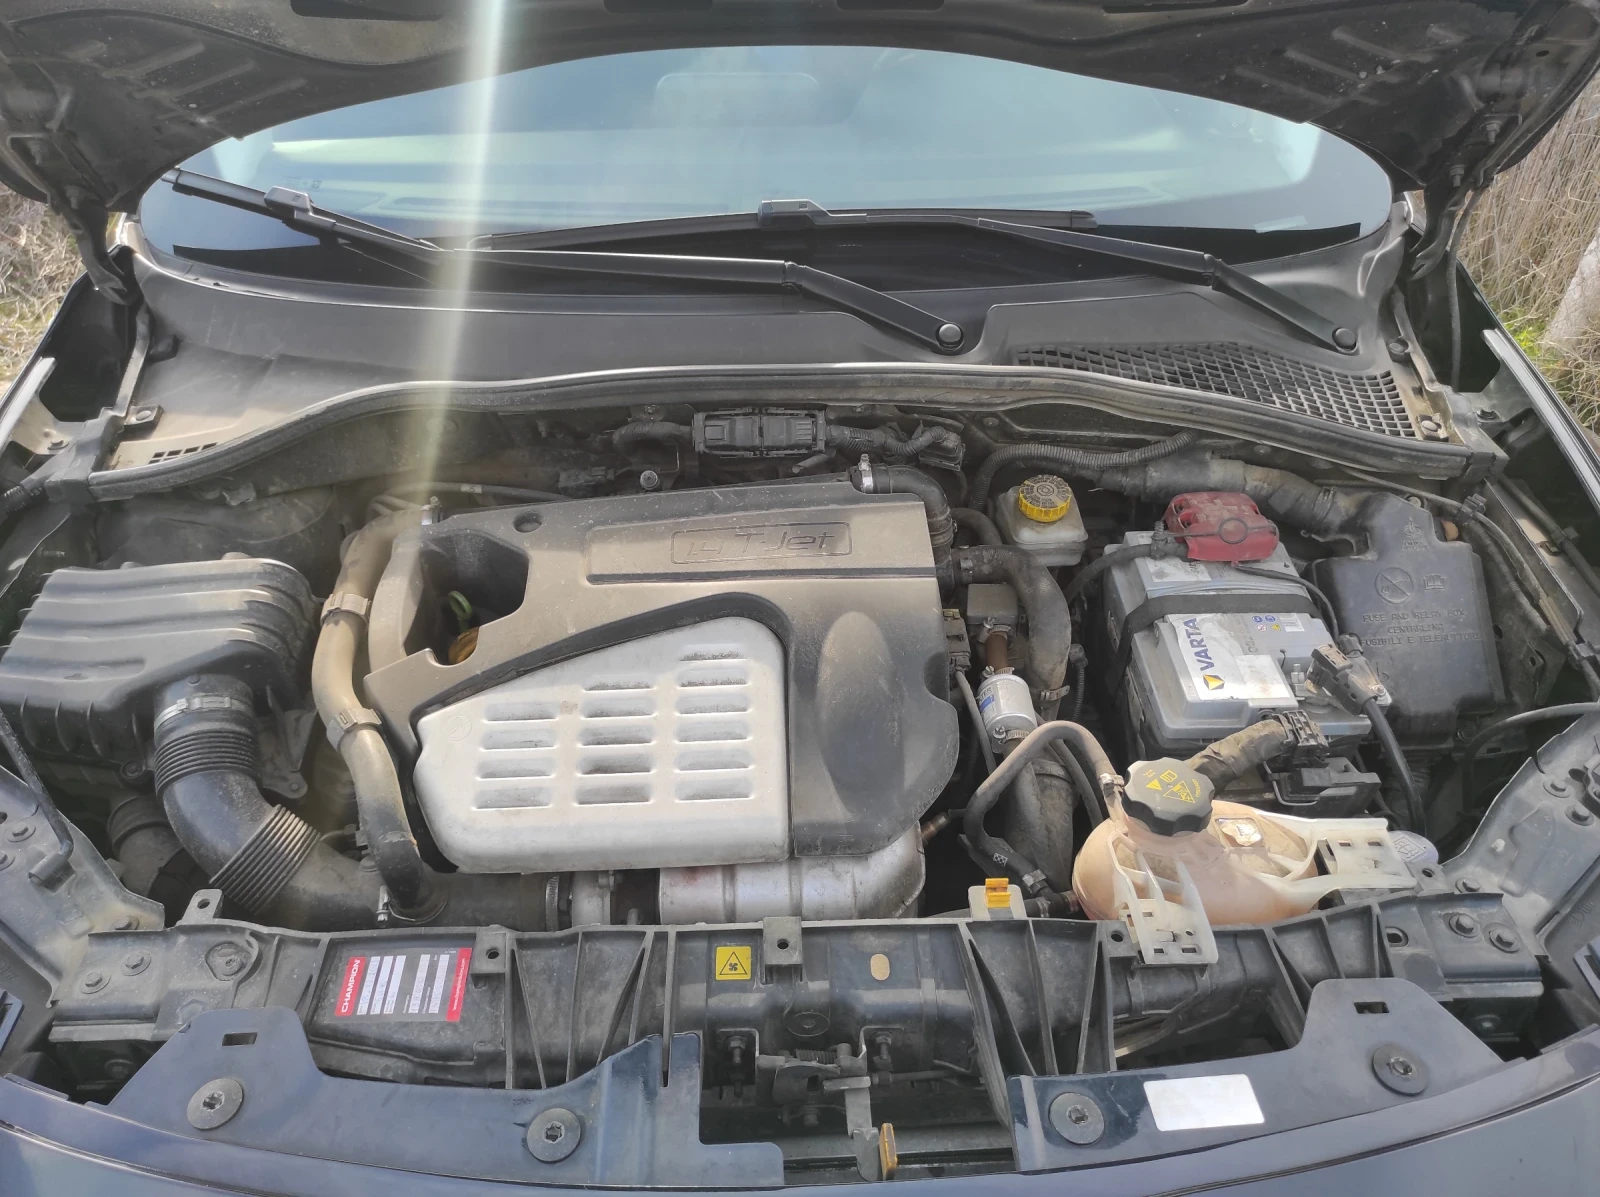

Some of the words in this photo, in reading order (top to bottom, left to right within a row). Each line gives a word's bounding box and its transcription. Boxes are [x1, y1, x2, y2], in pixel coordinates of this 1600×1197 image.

[686, 540, 725, 556] 1.4
[1362, 613, 1386, 623] FUSE
[1391, 612, 1408, 621] AND
[1414, 611, 1441, 620] RELAY
[1447, 608, 1465, 617] BOX
[1387, 623, 1445, 634] CENTRALINA
[1183, 618, 1215, 671] VARTA
[1407, 636, 1414, 644] E
[341, 959, 361, 1013] CHAMPION
